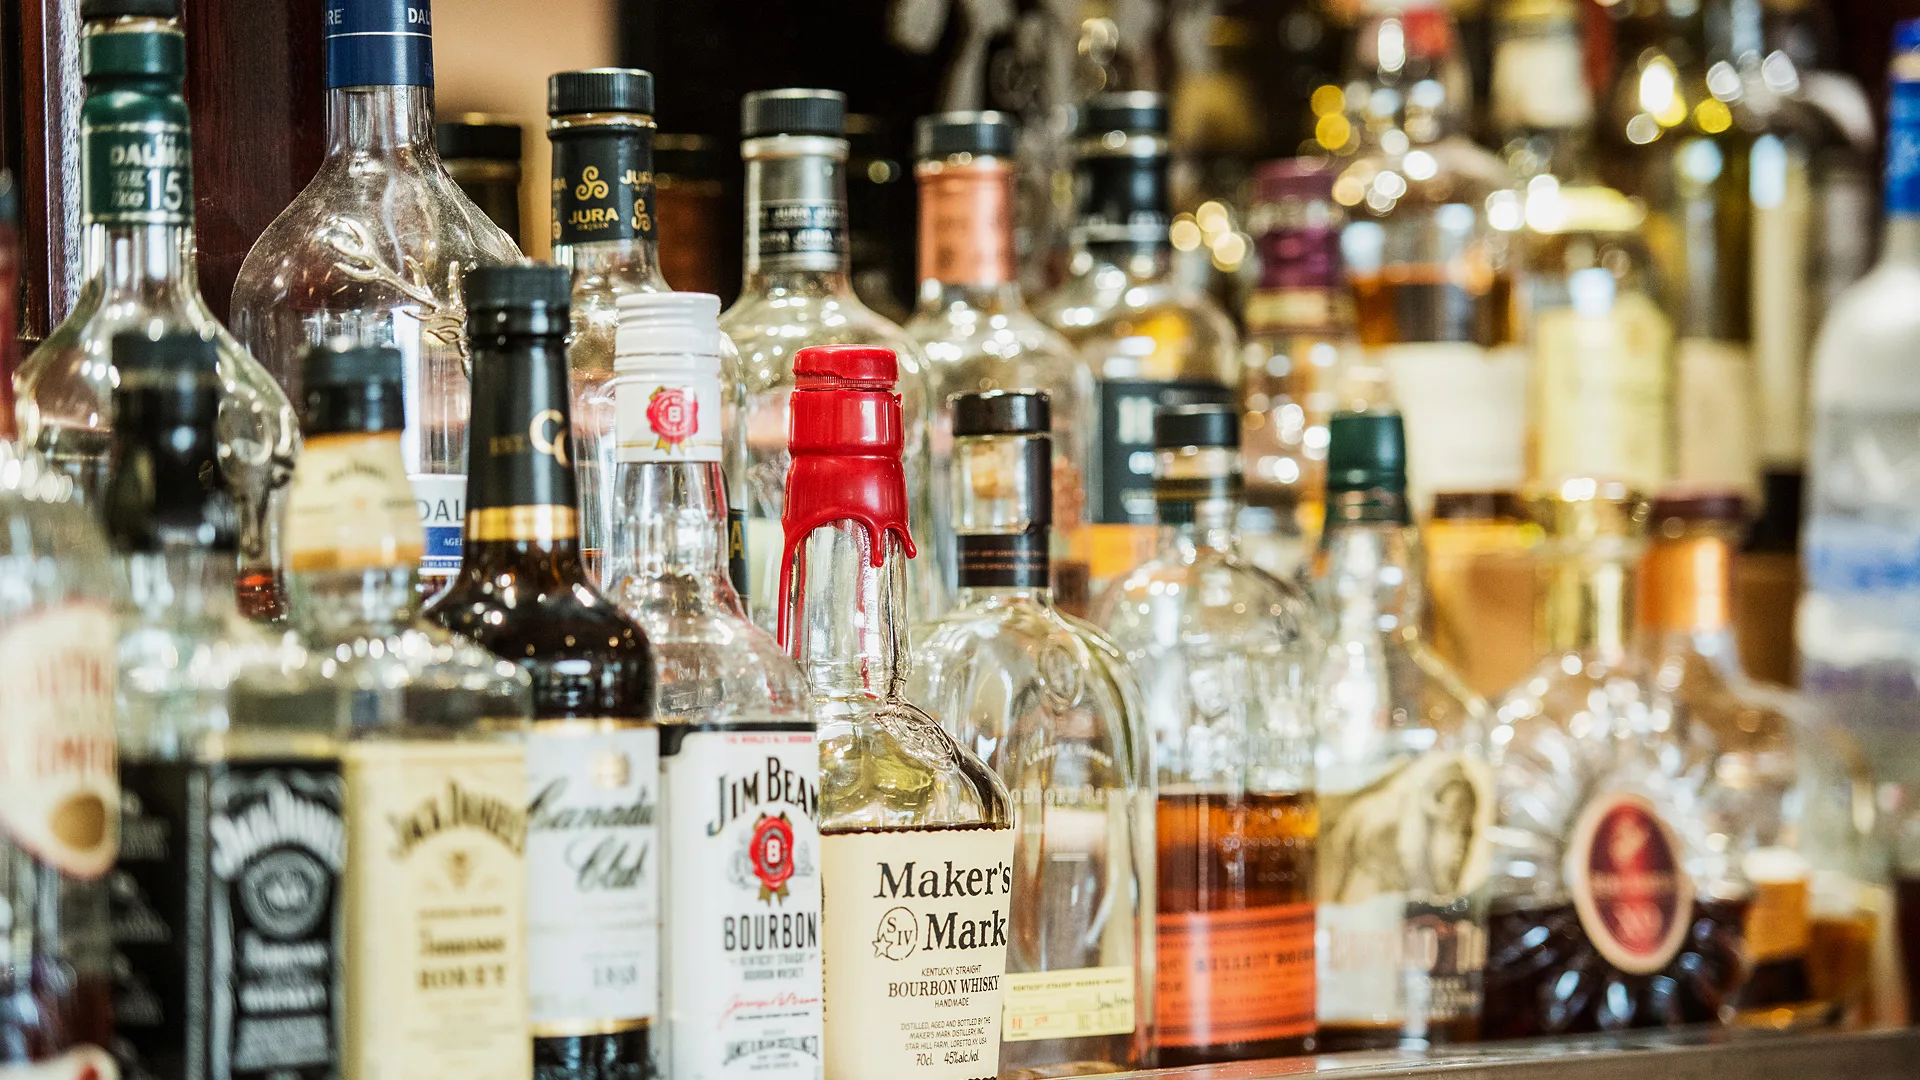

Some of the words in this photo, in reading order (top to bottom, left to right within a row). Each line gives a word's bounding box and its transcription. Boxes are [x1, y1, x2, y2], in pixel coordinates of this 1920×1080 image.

[325, 9, 343, 25] RE
[407, 8, 431, 25] DAL
[147, 169, 183, 211] 15
[568, 207, 619, 225] JURA
[668, 406, 681, 422] B
[417, 499, 465, 521] DAL
[706, 771, 759, 837] JIM
[766, 838, 781, 863] B
[873, 860, 1011, 899] Maker's
[723, 911, 817, 951] BOURBON
[886, 916, 897, 934] S
[922, 909, 1007, 951] Mark
[897, 930, 913, 946] IV
[921, 967, 955, 977] KENTUCKY
[956, 964, 982, 976] STRAIGHT
[888, 979, 957, 998] BOURBON
[960, 975, 1000, 994] WHISKY
[934, 997, 970, 1008] HANDMADE
[931, 1020, 945, 1029] AGED
[946, 1020, 956, 1028] AND
[957, 1018, 977, 1027] BOTTLED
[977, 1017, 983, 1025] BY
[983, 1016, 991, 1024] THE
[905, 1042, 919, 1051] STAR
[920, 1041, 932, 1050] HILL
[979, 1037, 987, 1045] USA
[909, 1031, 935, 1040] MAKER'S
[935, 1030, 951, 1038] MARK
